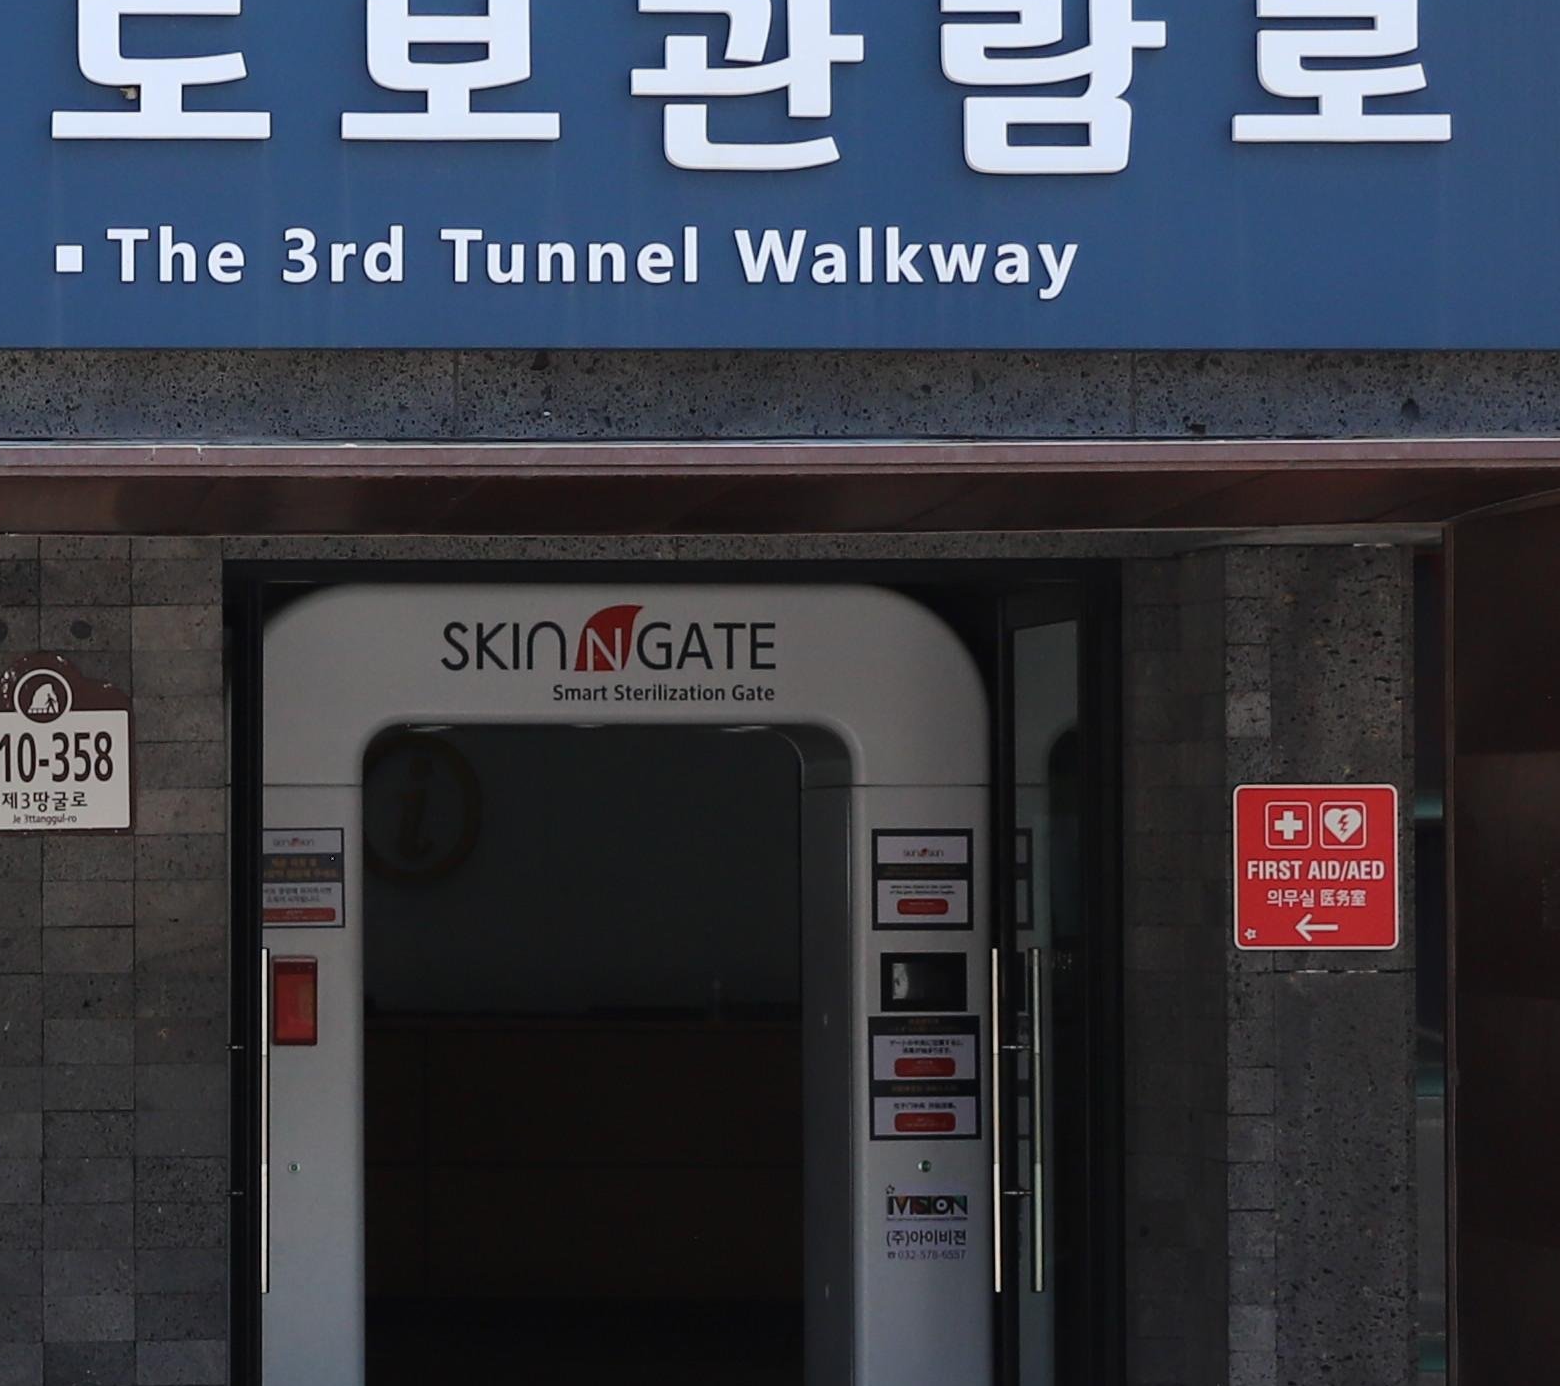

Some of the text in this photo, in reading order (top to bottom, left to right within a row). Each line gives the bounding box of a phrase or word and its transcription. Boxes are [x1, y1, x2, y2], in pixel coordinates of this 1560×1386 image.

[108, 226, 1077, 299] The 3rd Tunnel Walkway
[554, 685, 774, 700] Smart Sterilization Gate
[3, 792, 87, 812] 제3땅굴로
[13, 815, 21, 823] Je
[1248, 861, 1384, 881] FIRST AID/AED
[1268, 889, 1365, 907] 의무실 医务室
